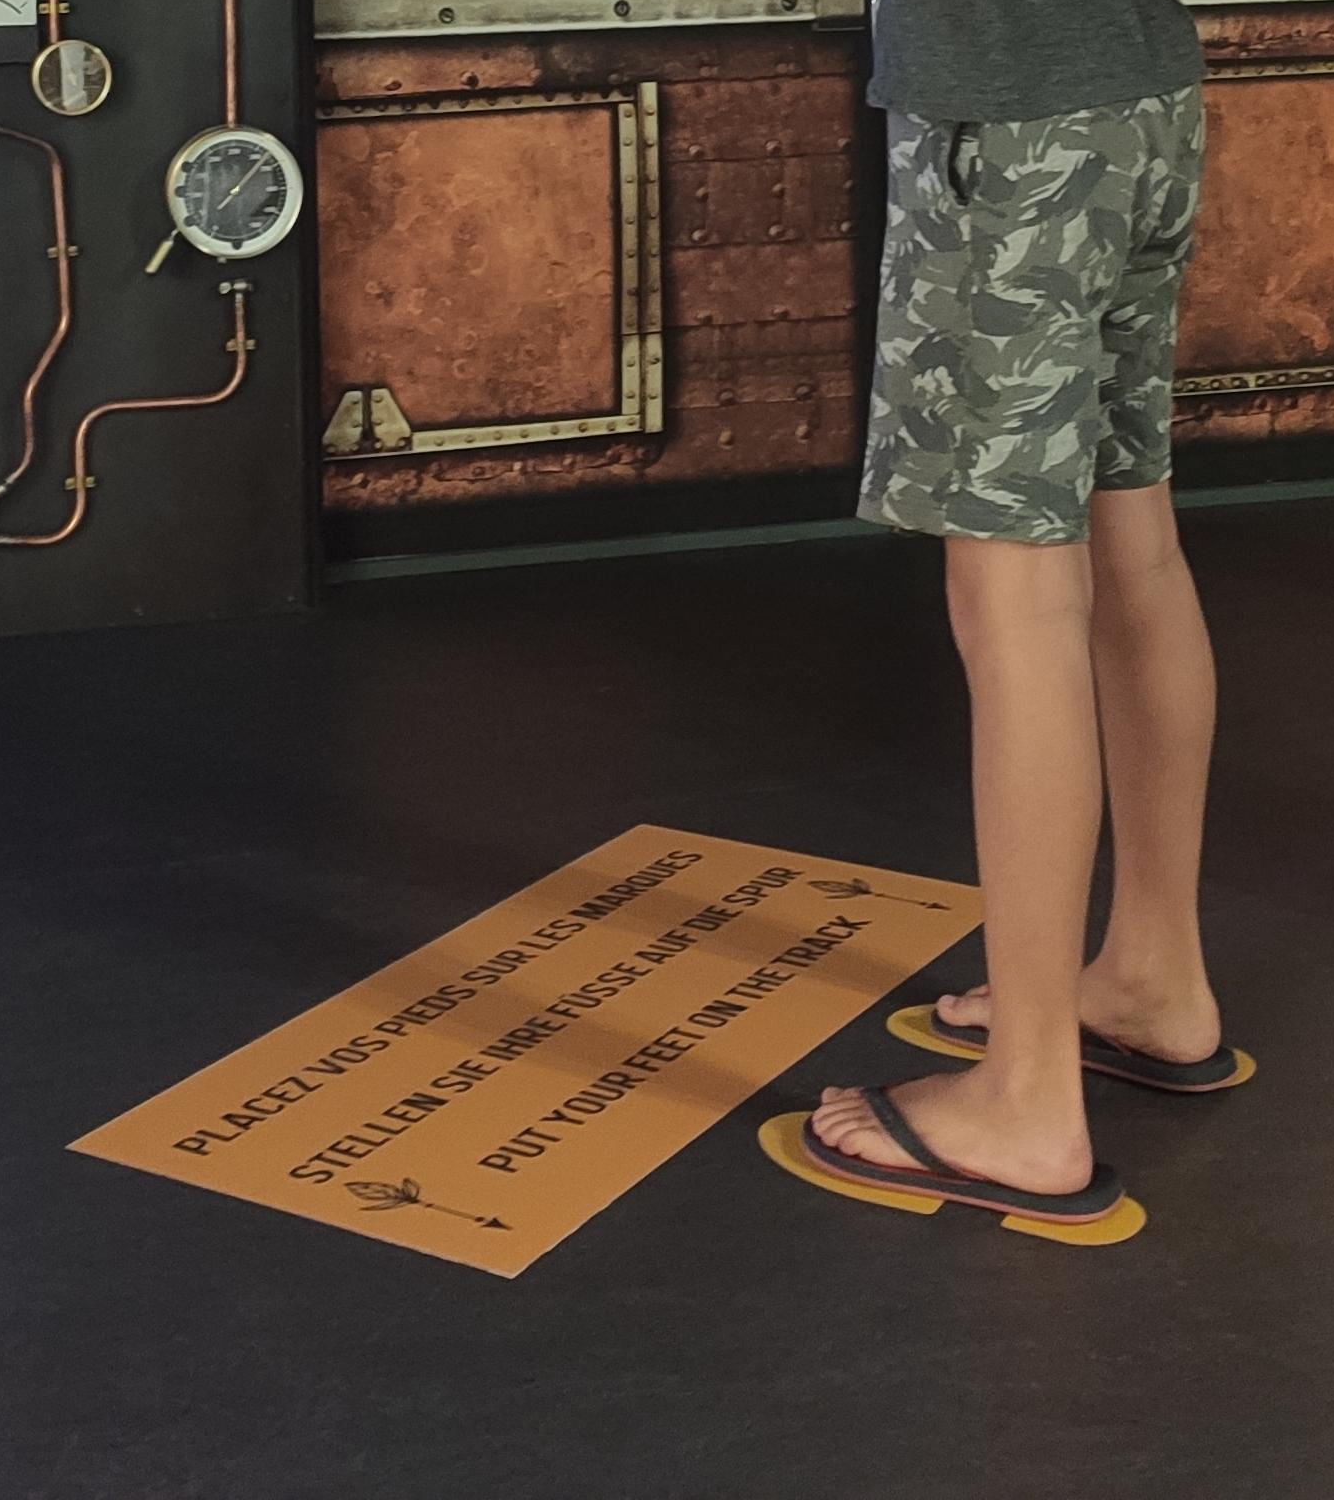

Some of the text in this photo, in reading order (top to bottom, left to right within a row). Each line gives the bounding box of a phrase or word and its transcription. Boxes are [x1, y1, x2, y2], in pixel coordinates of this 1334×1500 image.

[173, 849, 704, 1156] PLACEZ VOS PIEDS SUR LES MARQUES
[288, 1091, 449, 1185] STELLEN
[434, 1058, 500, 1095] SIE
[479, 1016, 569, 1063] IHRE
[635, 928, 699, 965] AUF
[683, 903, 742, 934] DIE
[721, 865, 804, 909] SPUR
[477, 914, 874, 1175] PUT YOUR FEET ON THE TRACK
